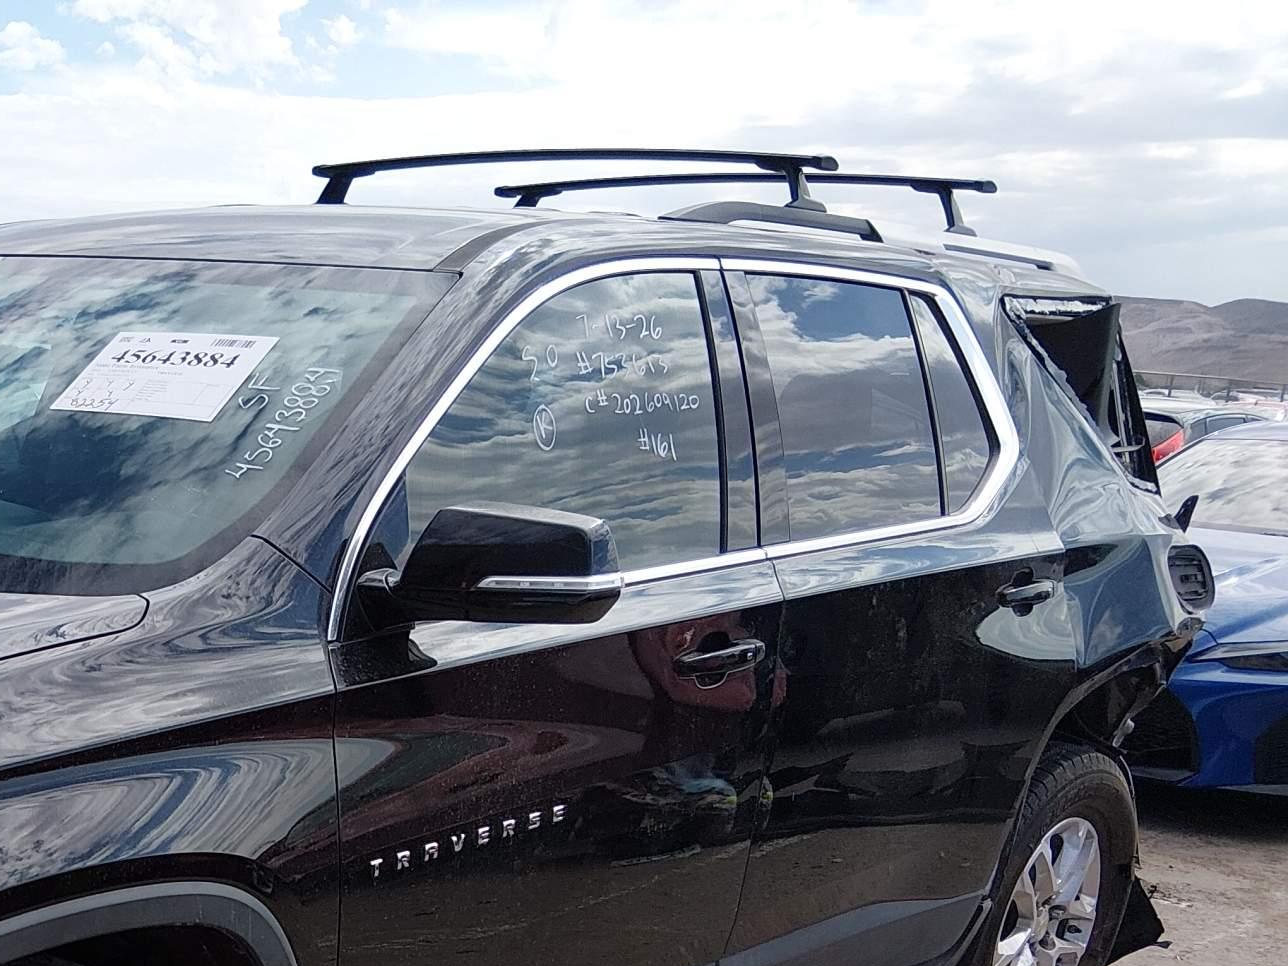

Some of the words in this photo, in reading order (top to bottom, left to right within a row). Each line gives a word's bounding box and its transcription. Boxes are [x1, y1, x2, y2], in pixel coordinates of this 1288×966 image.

[575, 314, 662, 340] 7-13-26
[112, 349, 241, 369] 45643884
[238, 371, 280, 410] SF
[224, 367, 343, 480] 45643884
[637, 427, 678, 461] #161
[370, 804, 568, 877] TRAVERSE
